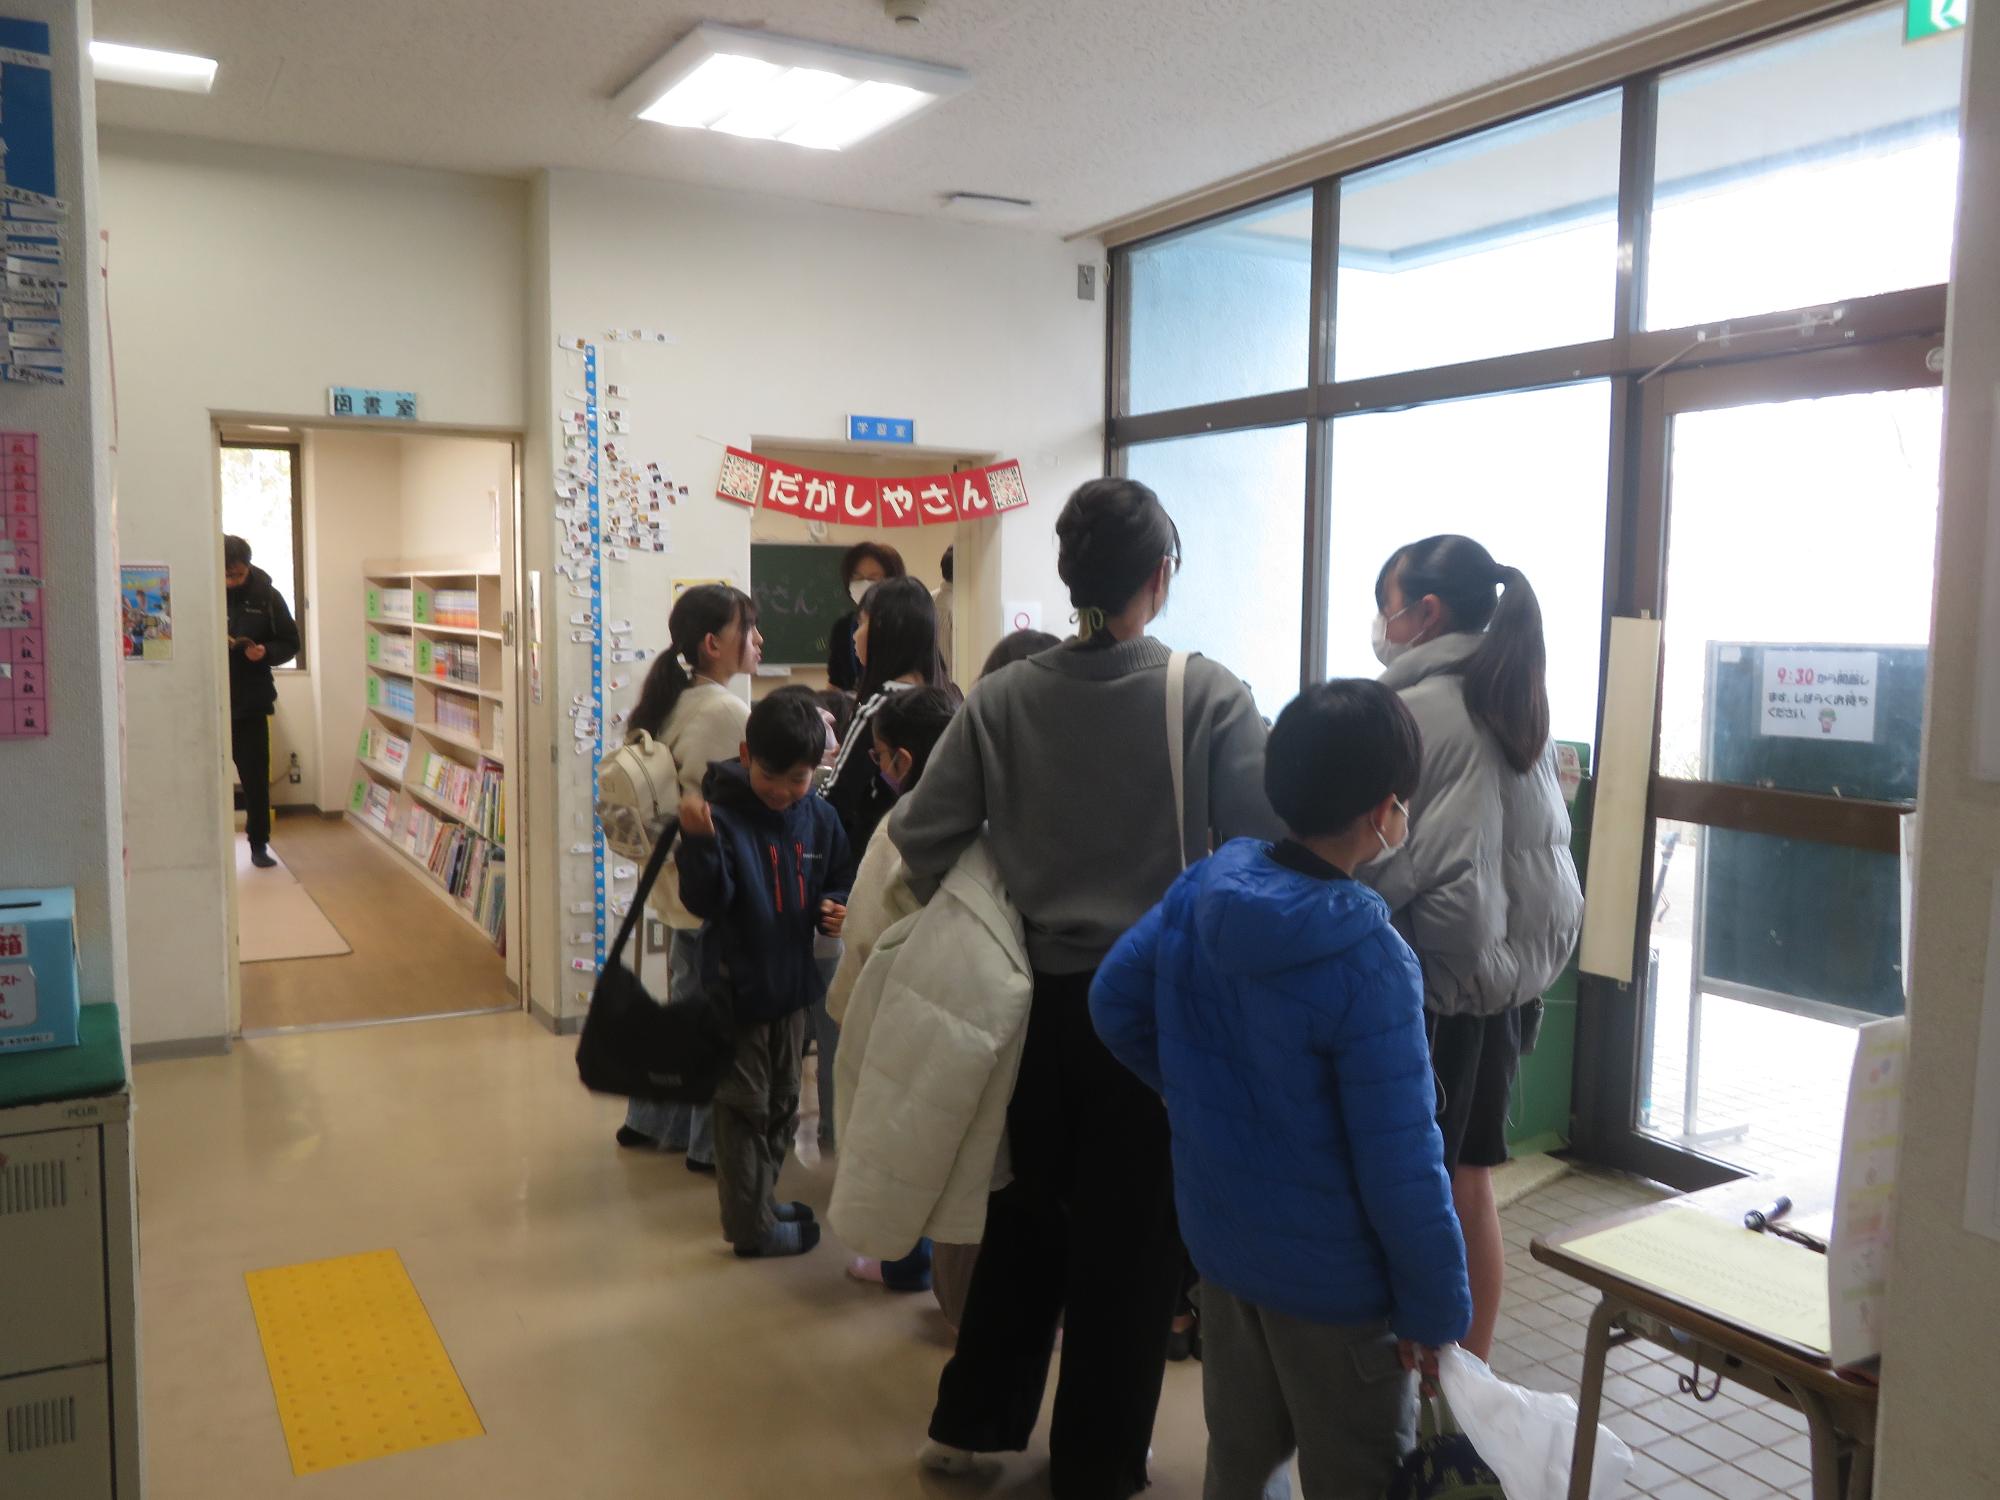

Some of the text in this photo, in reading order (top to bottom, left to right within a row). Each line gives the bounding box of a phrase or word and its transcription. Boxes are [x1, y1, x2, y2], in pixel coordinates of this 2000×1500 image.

[768, 468, 988, 519] だがしやさん
